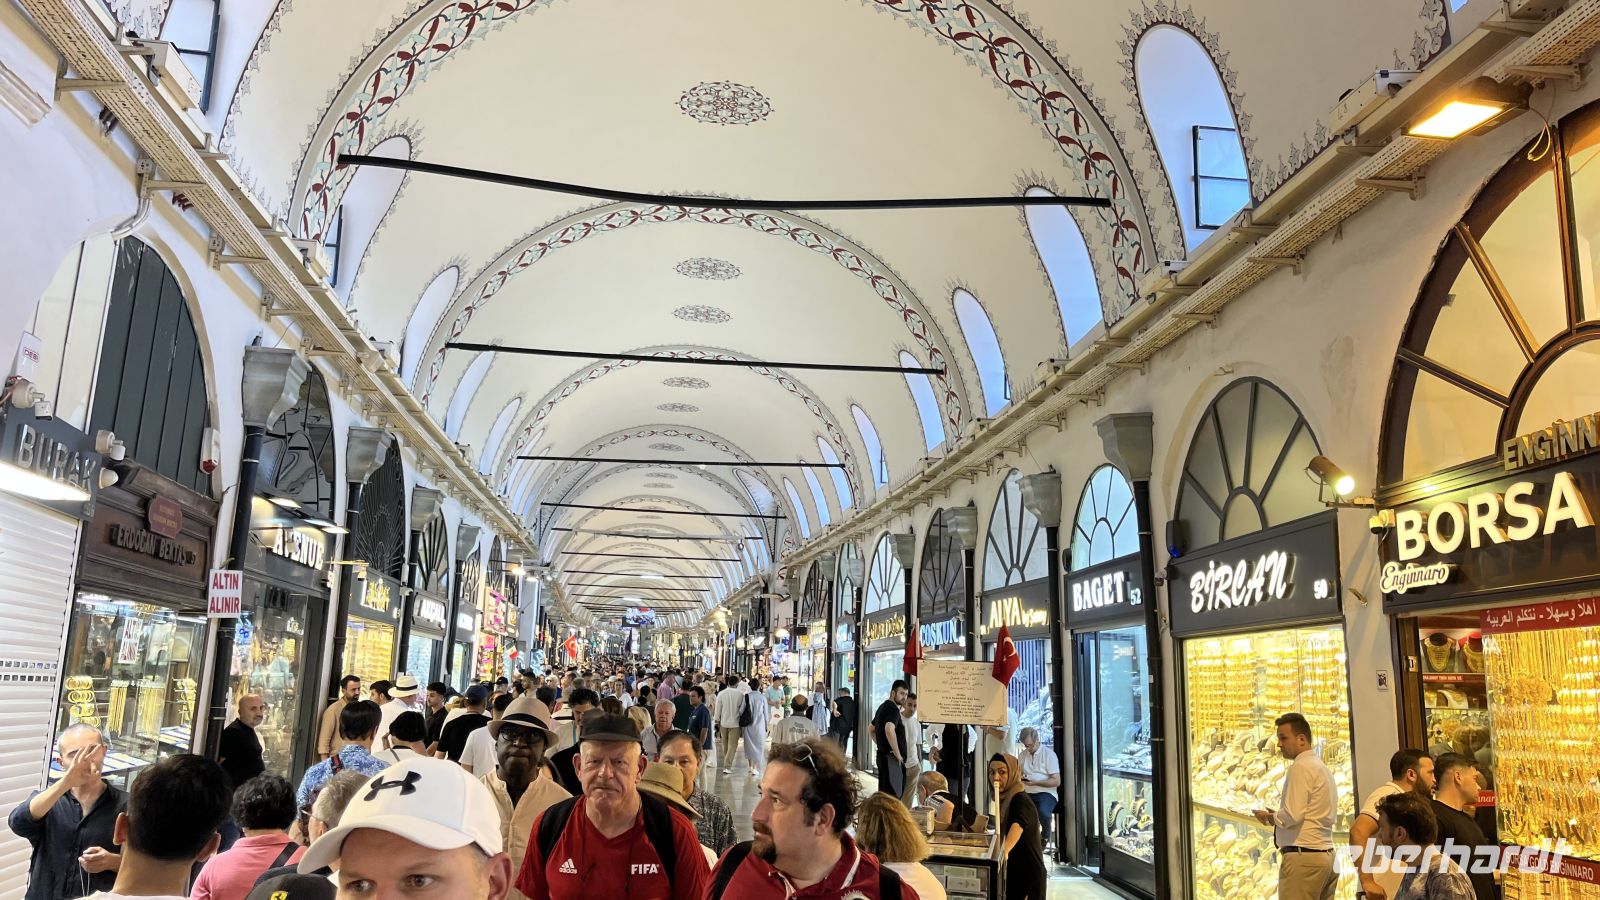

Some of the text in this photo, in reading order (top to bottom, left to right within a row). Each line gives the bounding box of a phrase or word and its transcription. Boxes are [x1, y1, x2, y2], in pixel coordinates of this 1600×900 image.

[1396, 472, 1590, 560] BORSA
[212, 573, 239, 590] ALTIN
[1190, 551, 1328, 613] BİRCAN 50
[1381, 563, 1448, 592] Enginnaro
[1072, 572, 1142, 611] BAGET 52
[209, 597, 240, 614] ALINIR
[1486, 610, 1514, 627] العربية
[1516, 608, 1537, 627] نتكلم
[631, 864, 658, 875] FIFA
